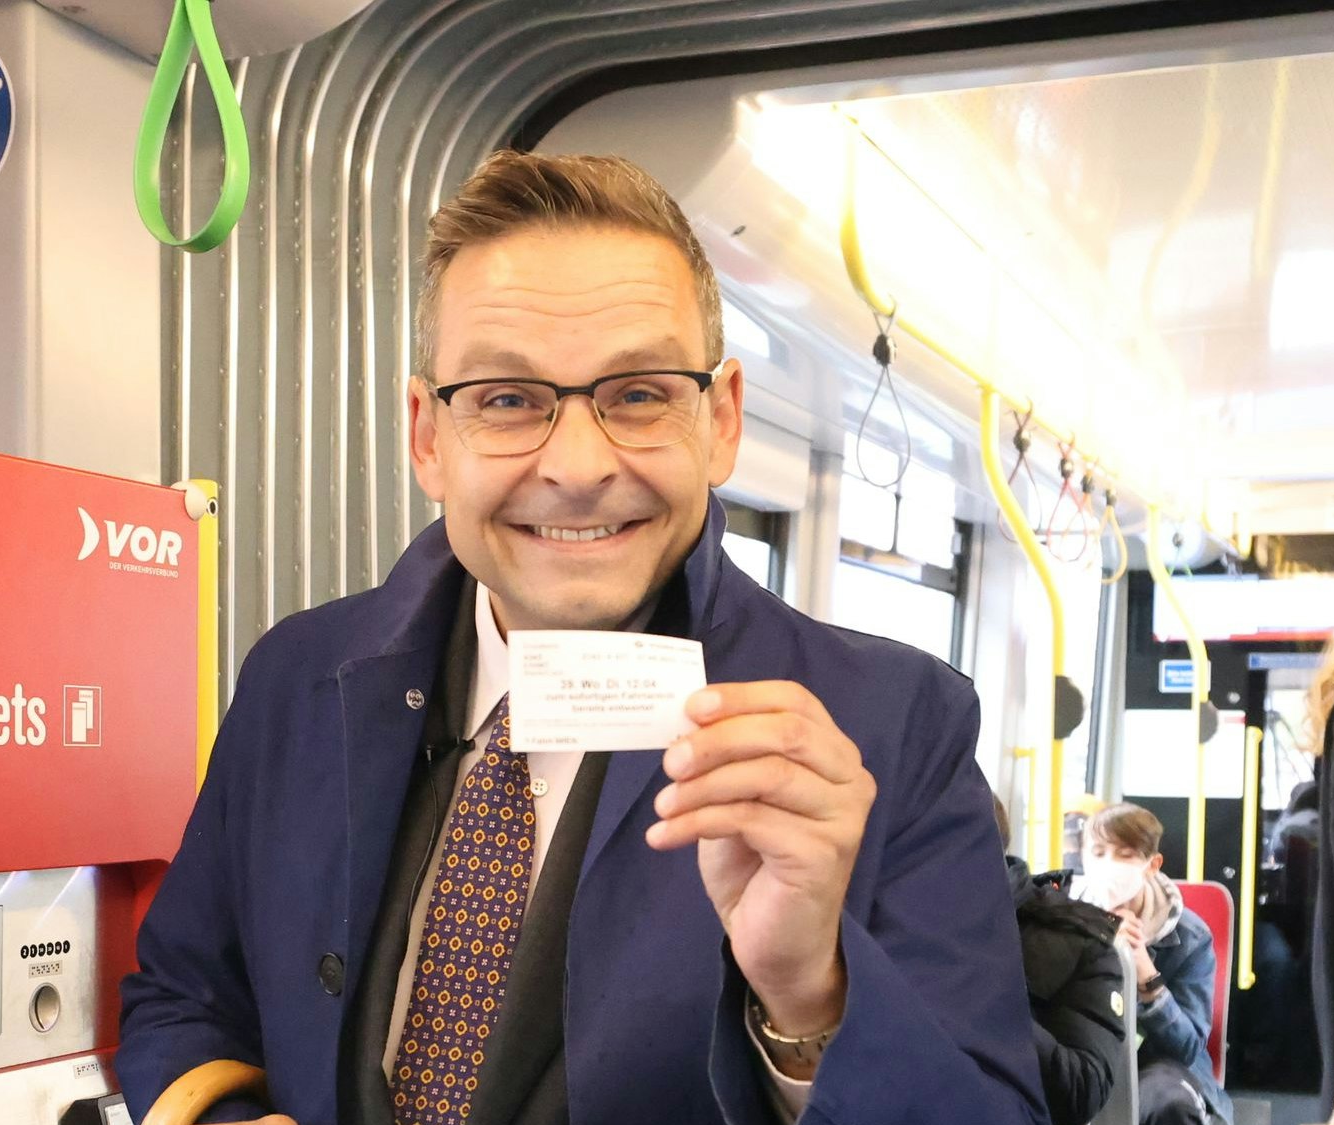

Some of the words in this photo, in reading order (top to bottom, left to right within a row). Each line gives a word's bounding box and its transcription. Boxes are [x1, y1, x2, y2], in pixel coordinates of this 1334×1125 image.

[103, 519, 182, 566] VOR
[109, 561, 122, 570] DER
[123, 563, 179, 579] VERKEHRSVERBUND
